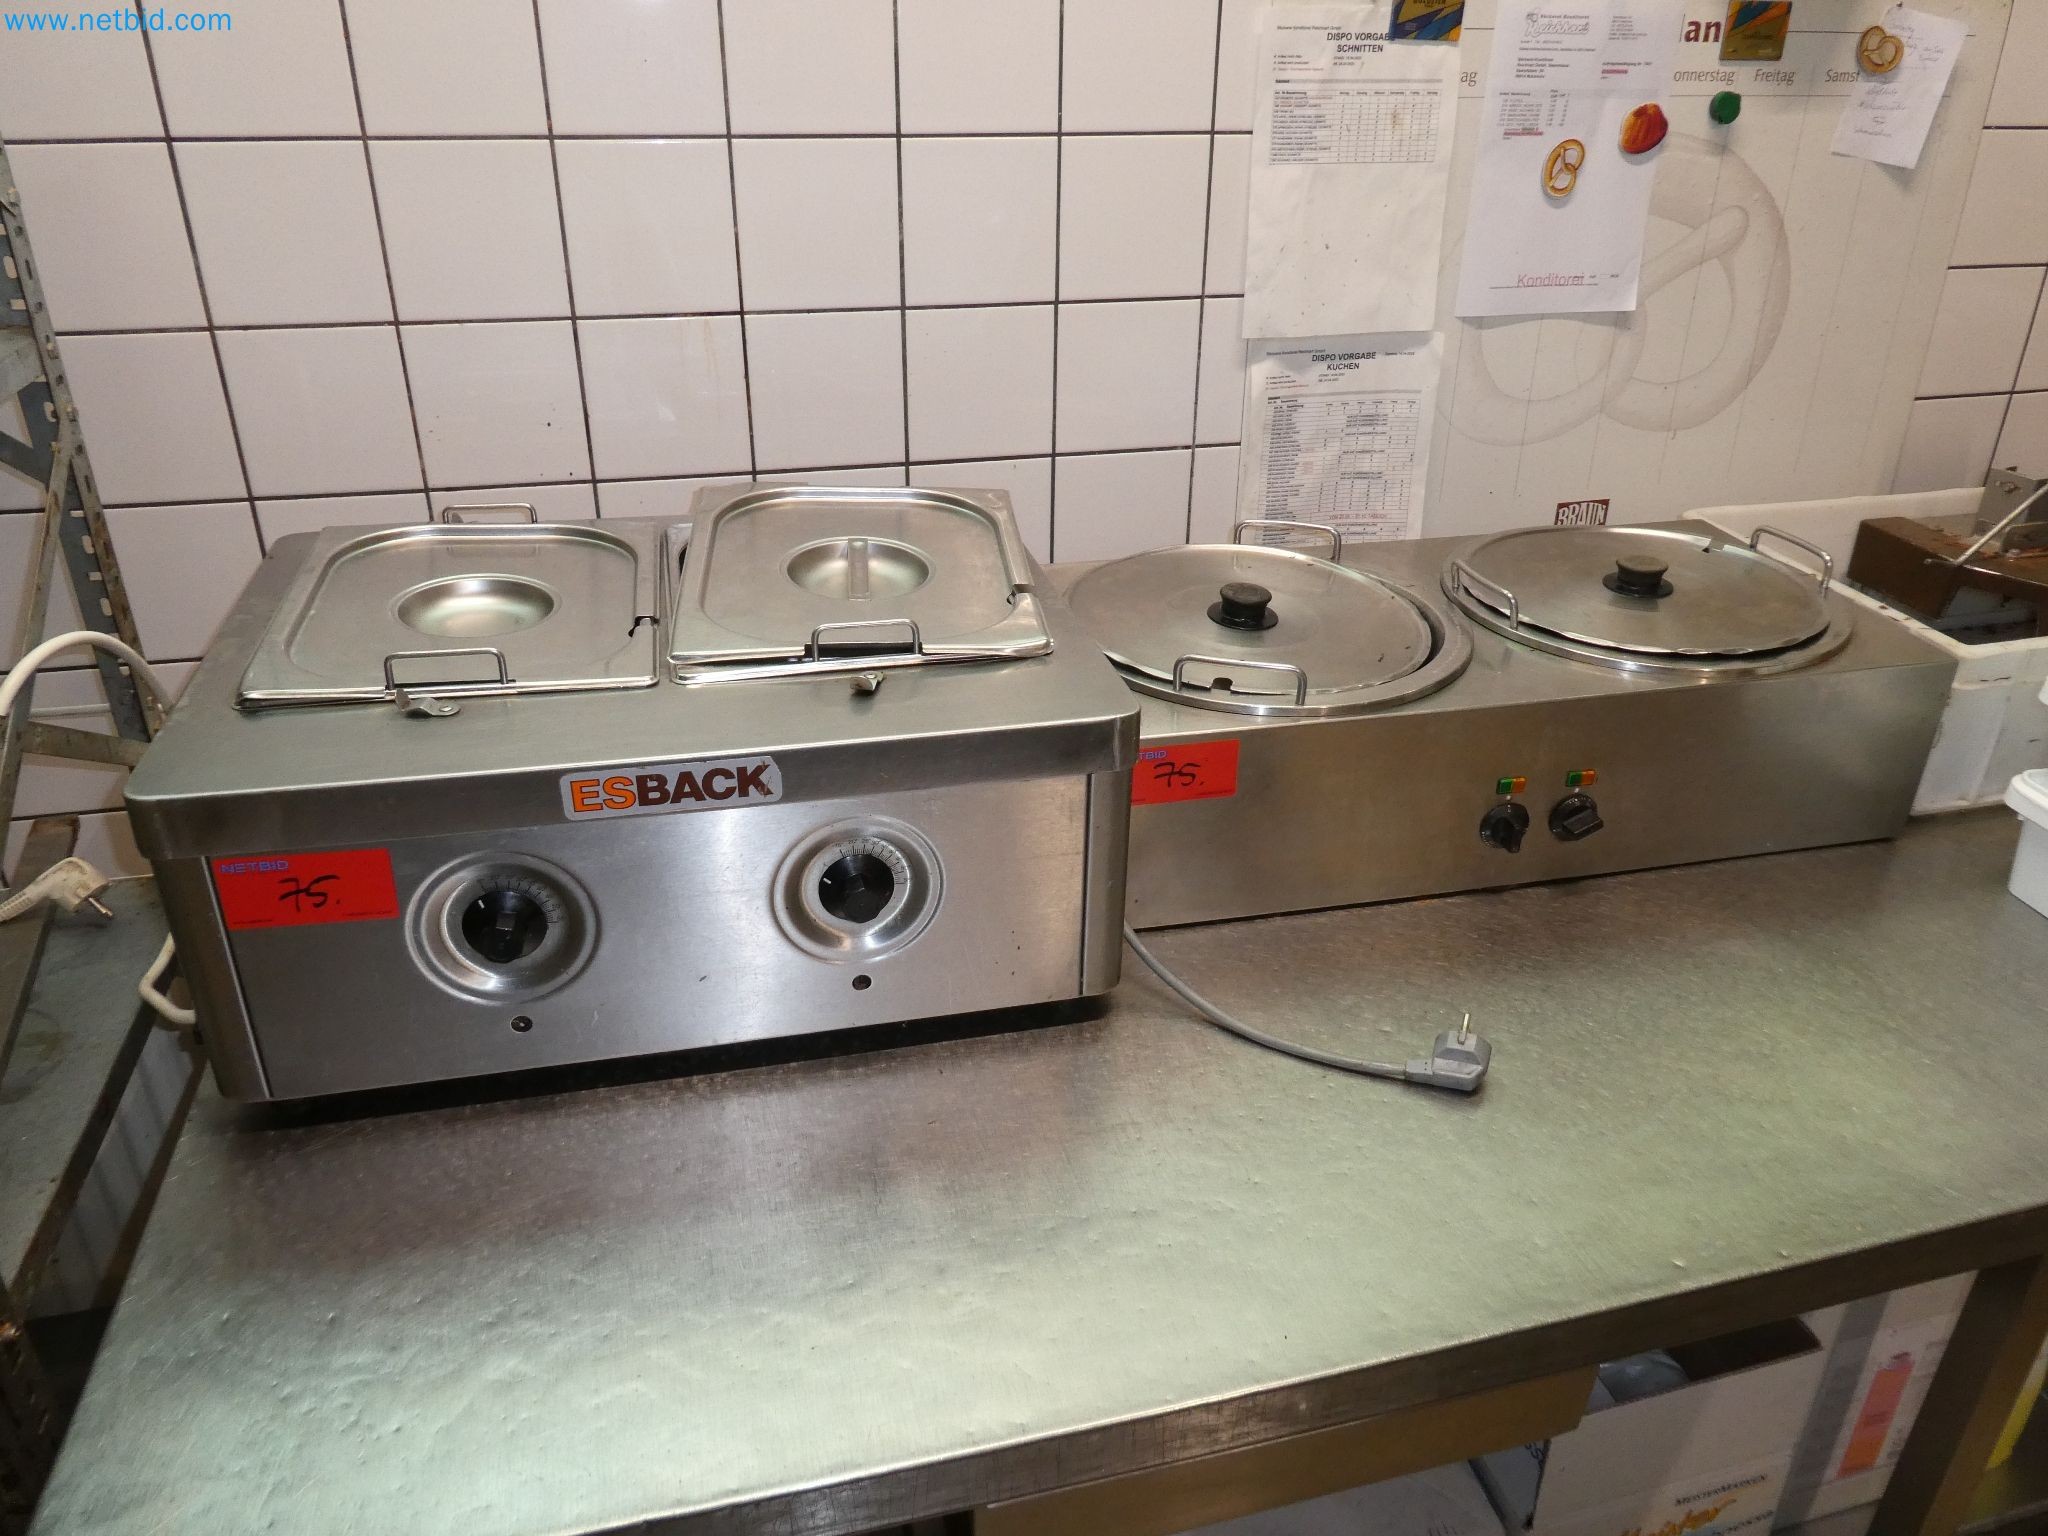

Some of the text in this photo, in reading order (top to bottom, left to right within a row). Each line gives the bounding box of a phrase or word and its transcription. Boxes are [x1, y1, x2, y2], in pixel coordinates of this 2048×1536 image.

[1327, 32, 1391, 41] DISPO VORGAB
[1336, 44, 1384, 53] SCHNITTEN
[1673, 68, 1737, 86] onnerstag
[1753, 68, 1797, 86] Freitag
[1517, 272, 1585, 288] Konditorei
[1312, 353, 1336, 362] DISPO
[1338, 351, 1377, 361] VORGABE
[1326, 362, 1360, 371] KUCHEN
[570, 763, 774, 812] ESBACK
[220, 860, 289, 874] NETBID
